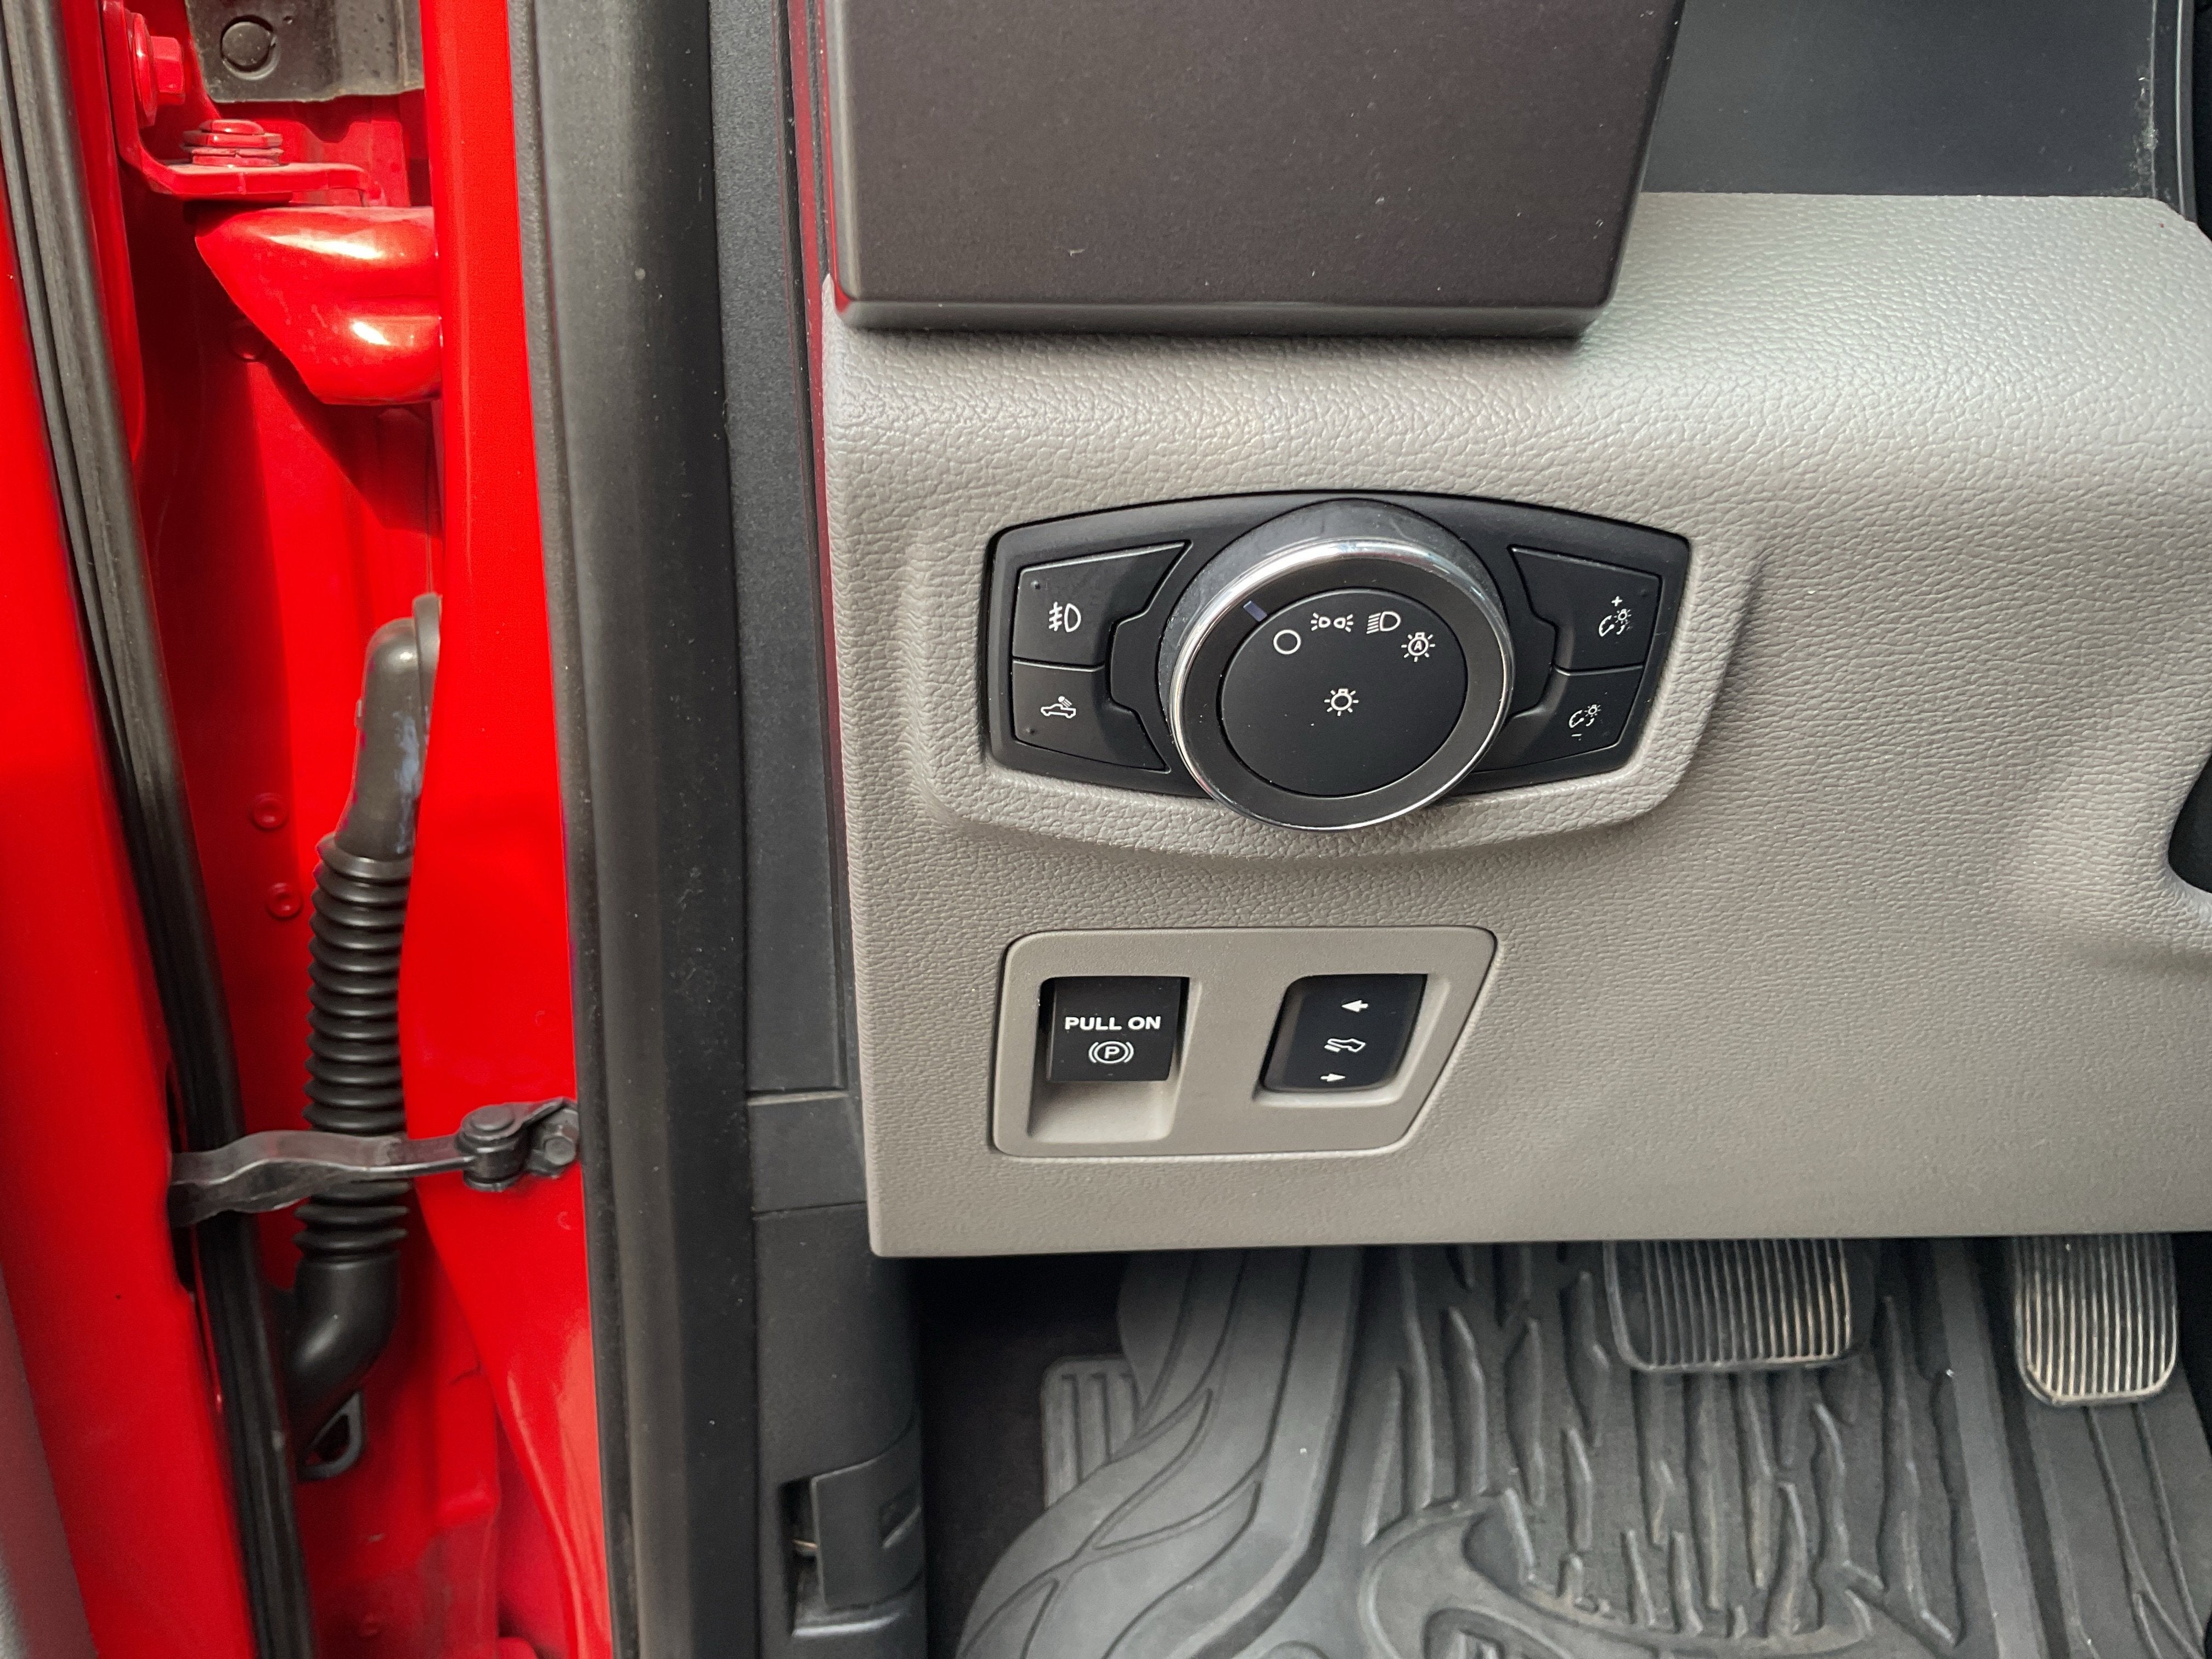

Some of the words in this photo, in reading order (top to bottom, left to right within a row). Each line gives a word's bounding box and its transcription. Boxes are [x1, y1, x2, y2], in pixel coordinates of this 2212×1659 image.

[1413, 640, 1422, 651] A
[1064, 1017, 1122, 1031] PULL
[1127, 1015, 1161, 1030] ON
[1104, 1046, 1120, 1059] P
